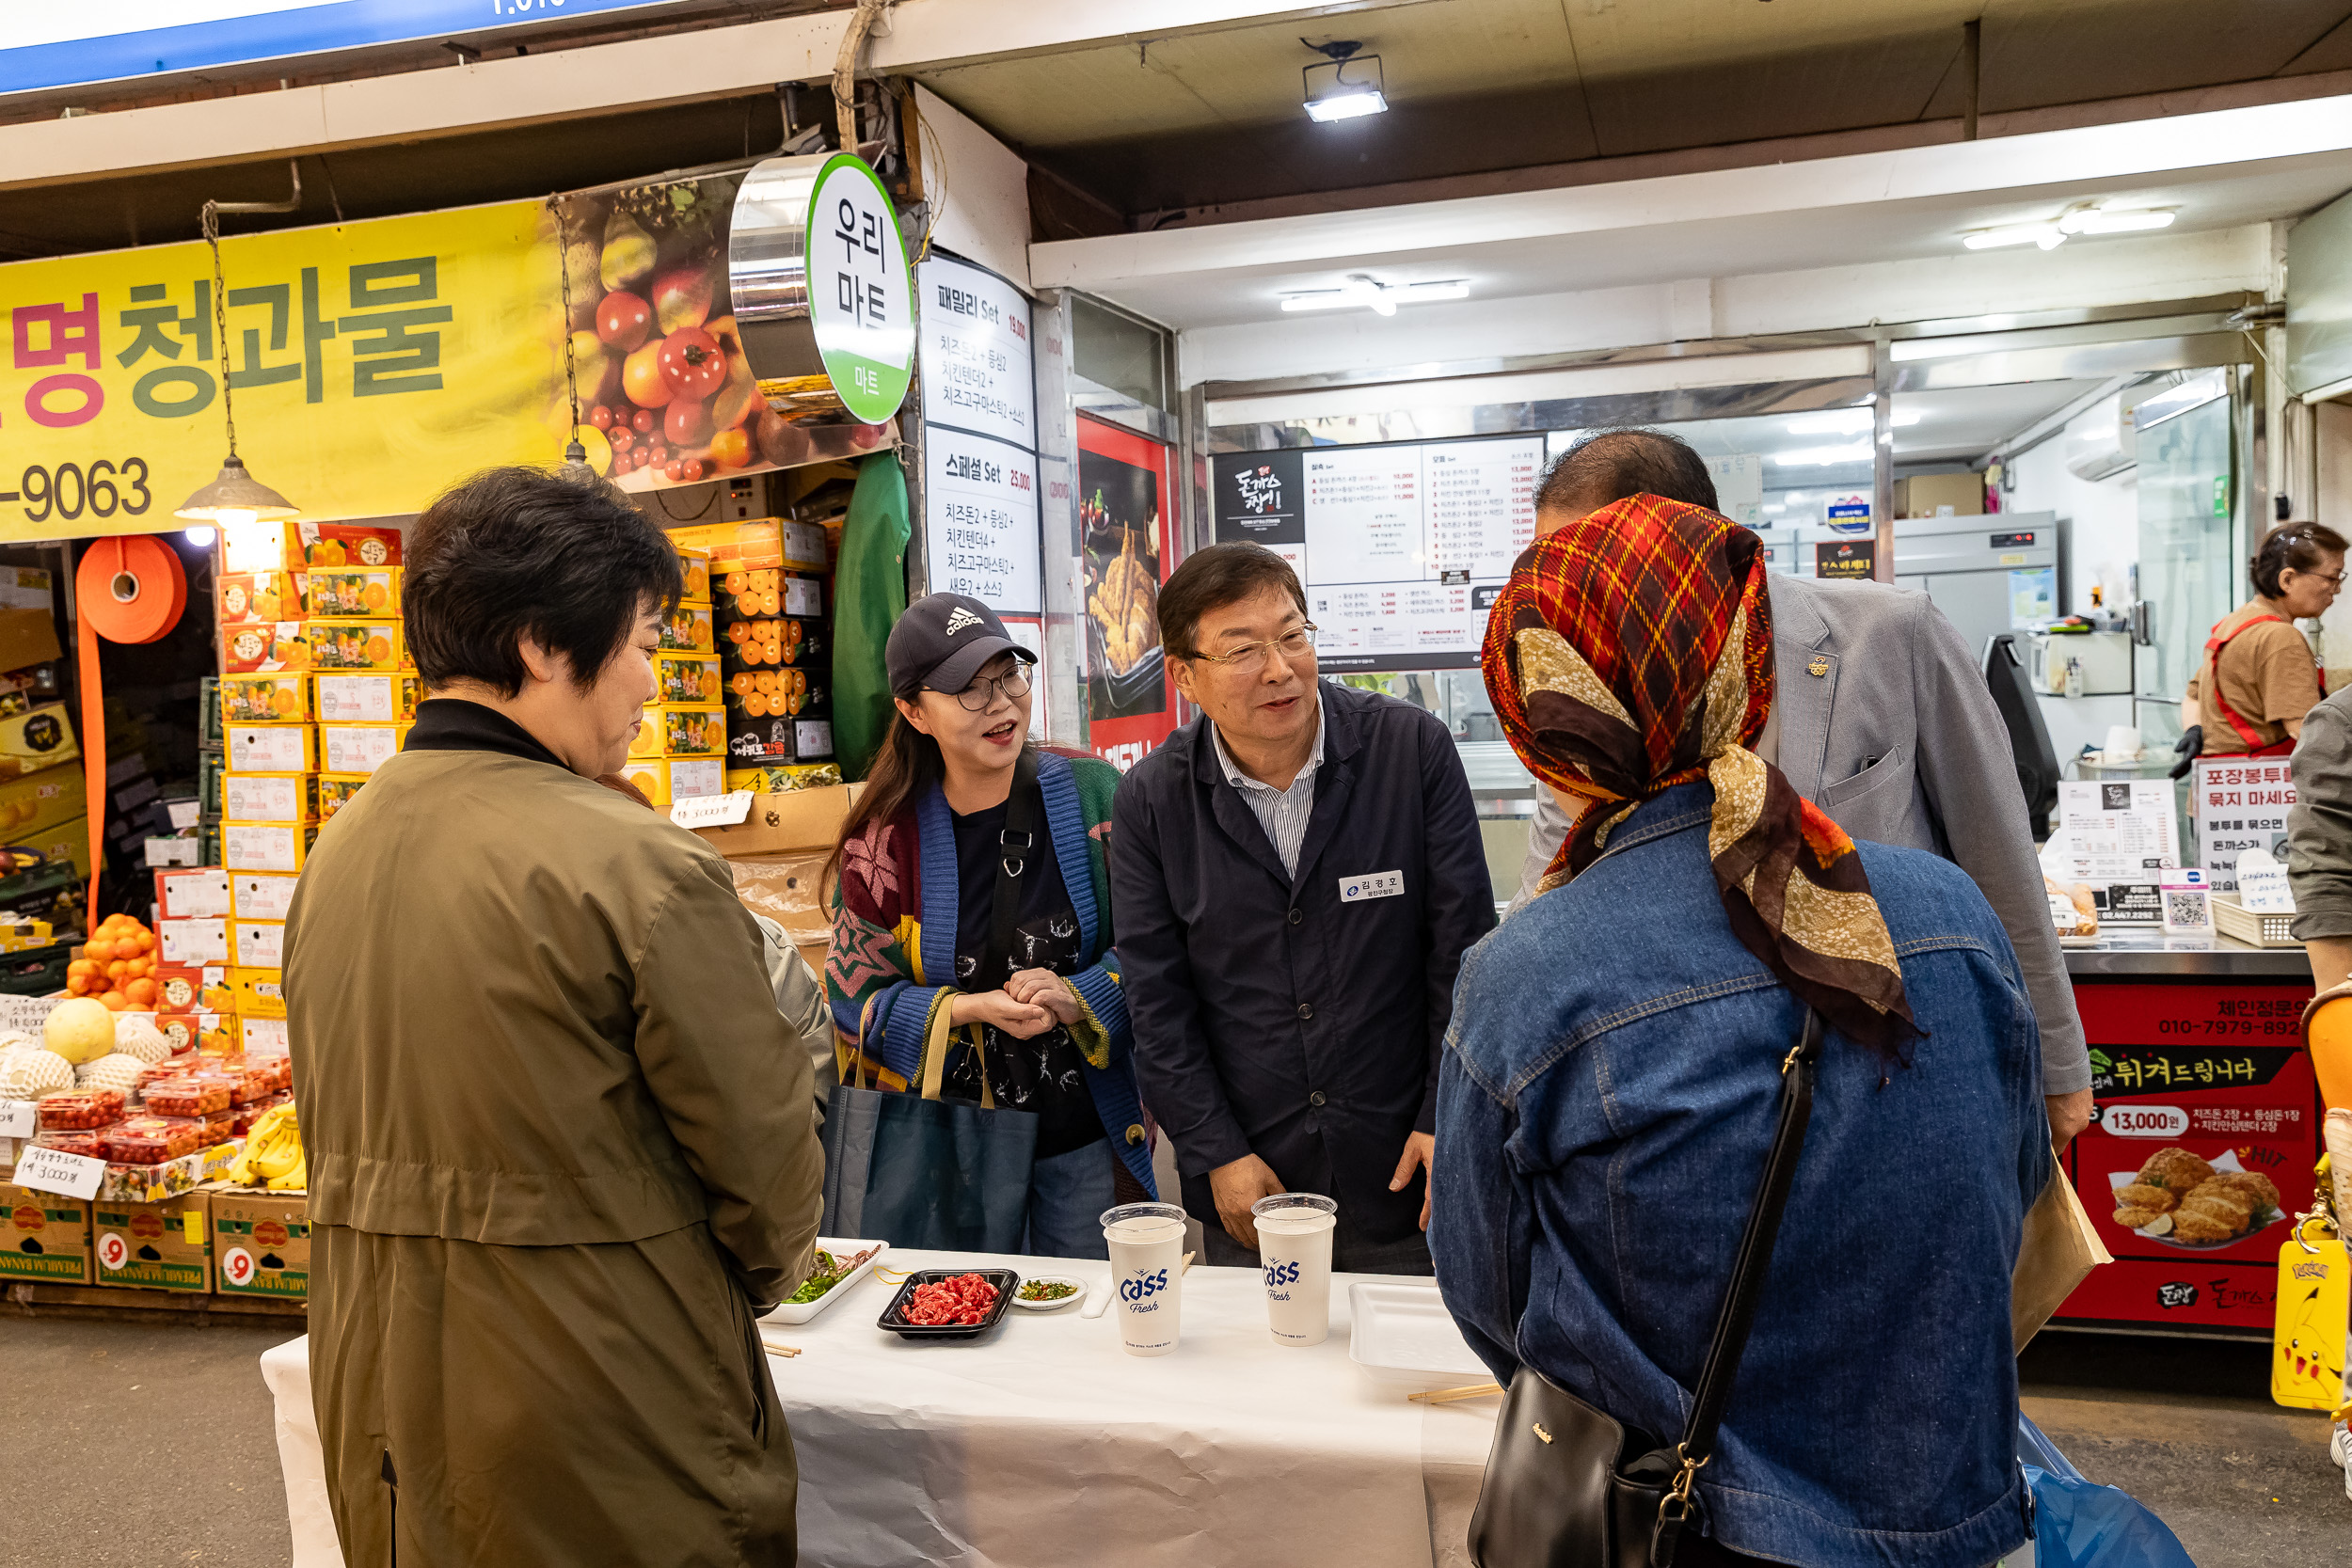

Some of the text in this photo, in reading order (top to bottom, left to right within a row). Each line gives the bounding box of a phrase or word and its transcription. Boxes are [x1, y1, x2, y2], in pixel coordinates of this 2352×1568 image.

[835, 198, 885, 274] 우리
[838, 271, 885, 329] 마트
[937, 285, 977, 318] 패밀리
[981, 299, 999, 325] Set
[0, 256, 453, 428] 명청과물
[988, 349, 1007, 372] 등심2
[854, 366, 880, 395] 마트
[942, 361, 986, 388] 치킨텐더2
[943, 386, 1008, 420] 치즈고구마스틱2
[946, 453, 1030, 492] 스페셜 Set 25,000
[1235, 469, 1281, 498] 돈까스
[946, 503, 979, 526] 치즈돈2
[990, 509, 1009, 530] 등심2
[946, 528, 989, 550] 치킨텐더4
[947, 553, 1009, 576] 치즈고구마스틱2
[949, 578, 973, 596] 새우2
[983, 581, 1003, 597] 소스3
[946, 617, 984, 636] adidas
[2209, 790, 2296, 807] 묶지 마세요
[2209, 819, 2282, 831] 봉투를 묶으면
[2211, 861, 2236, 871] 눅눅
[2159, 1021, 2300, 1036] 010-7979-892
[2251, 1146, 2287, 1168] HIT
[1129, 1300, 1159, 1313] Fresh
[1267, 1289, 1291, 1301] Fresh
